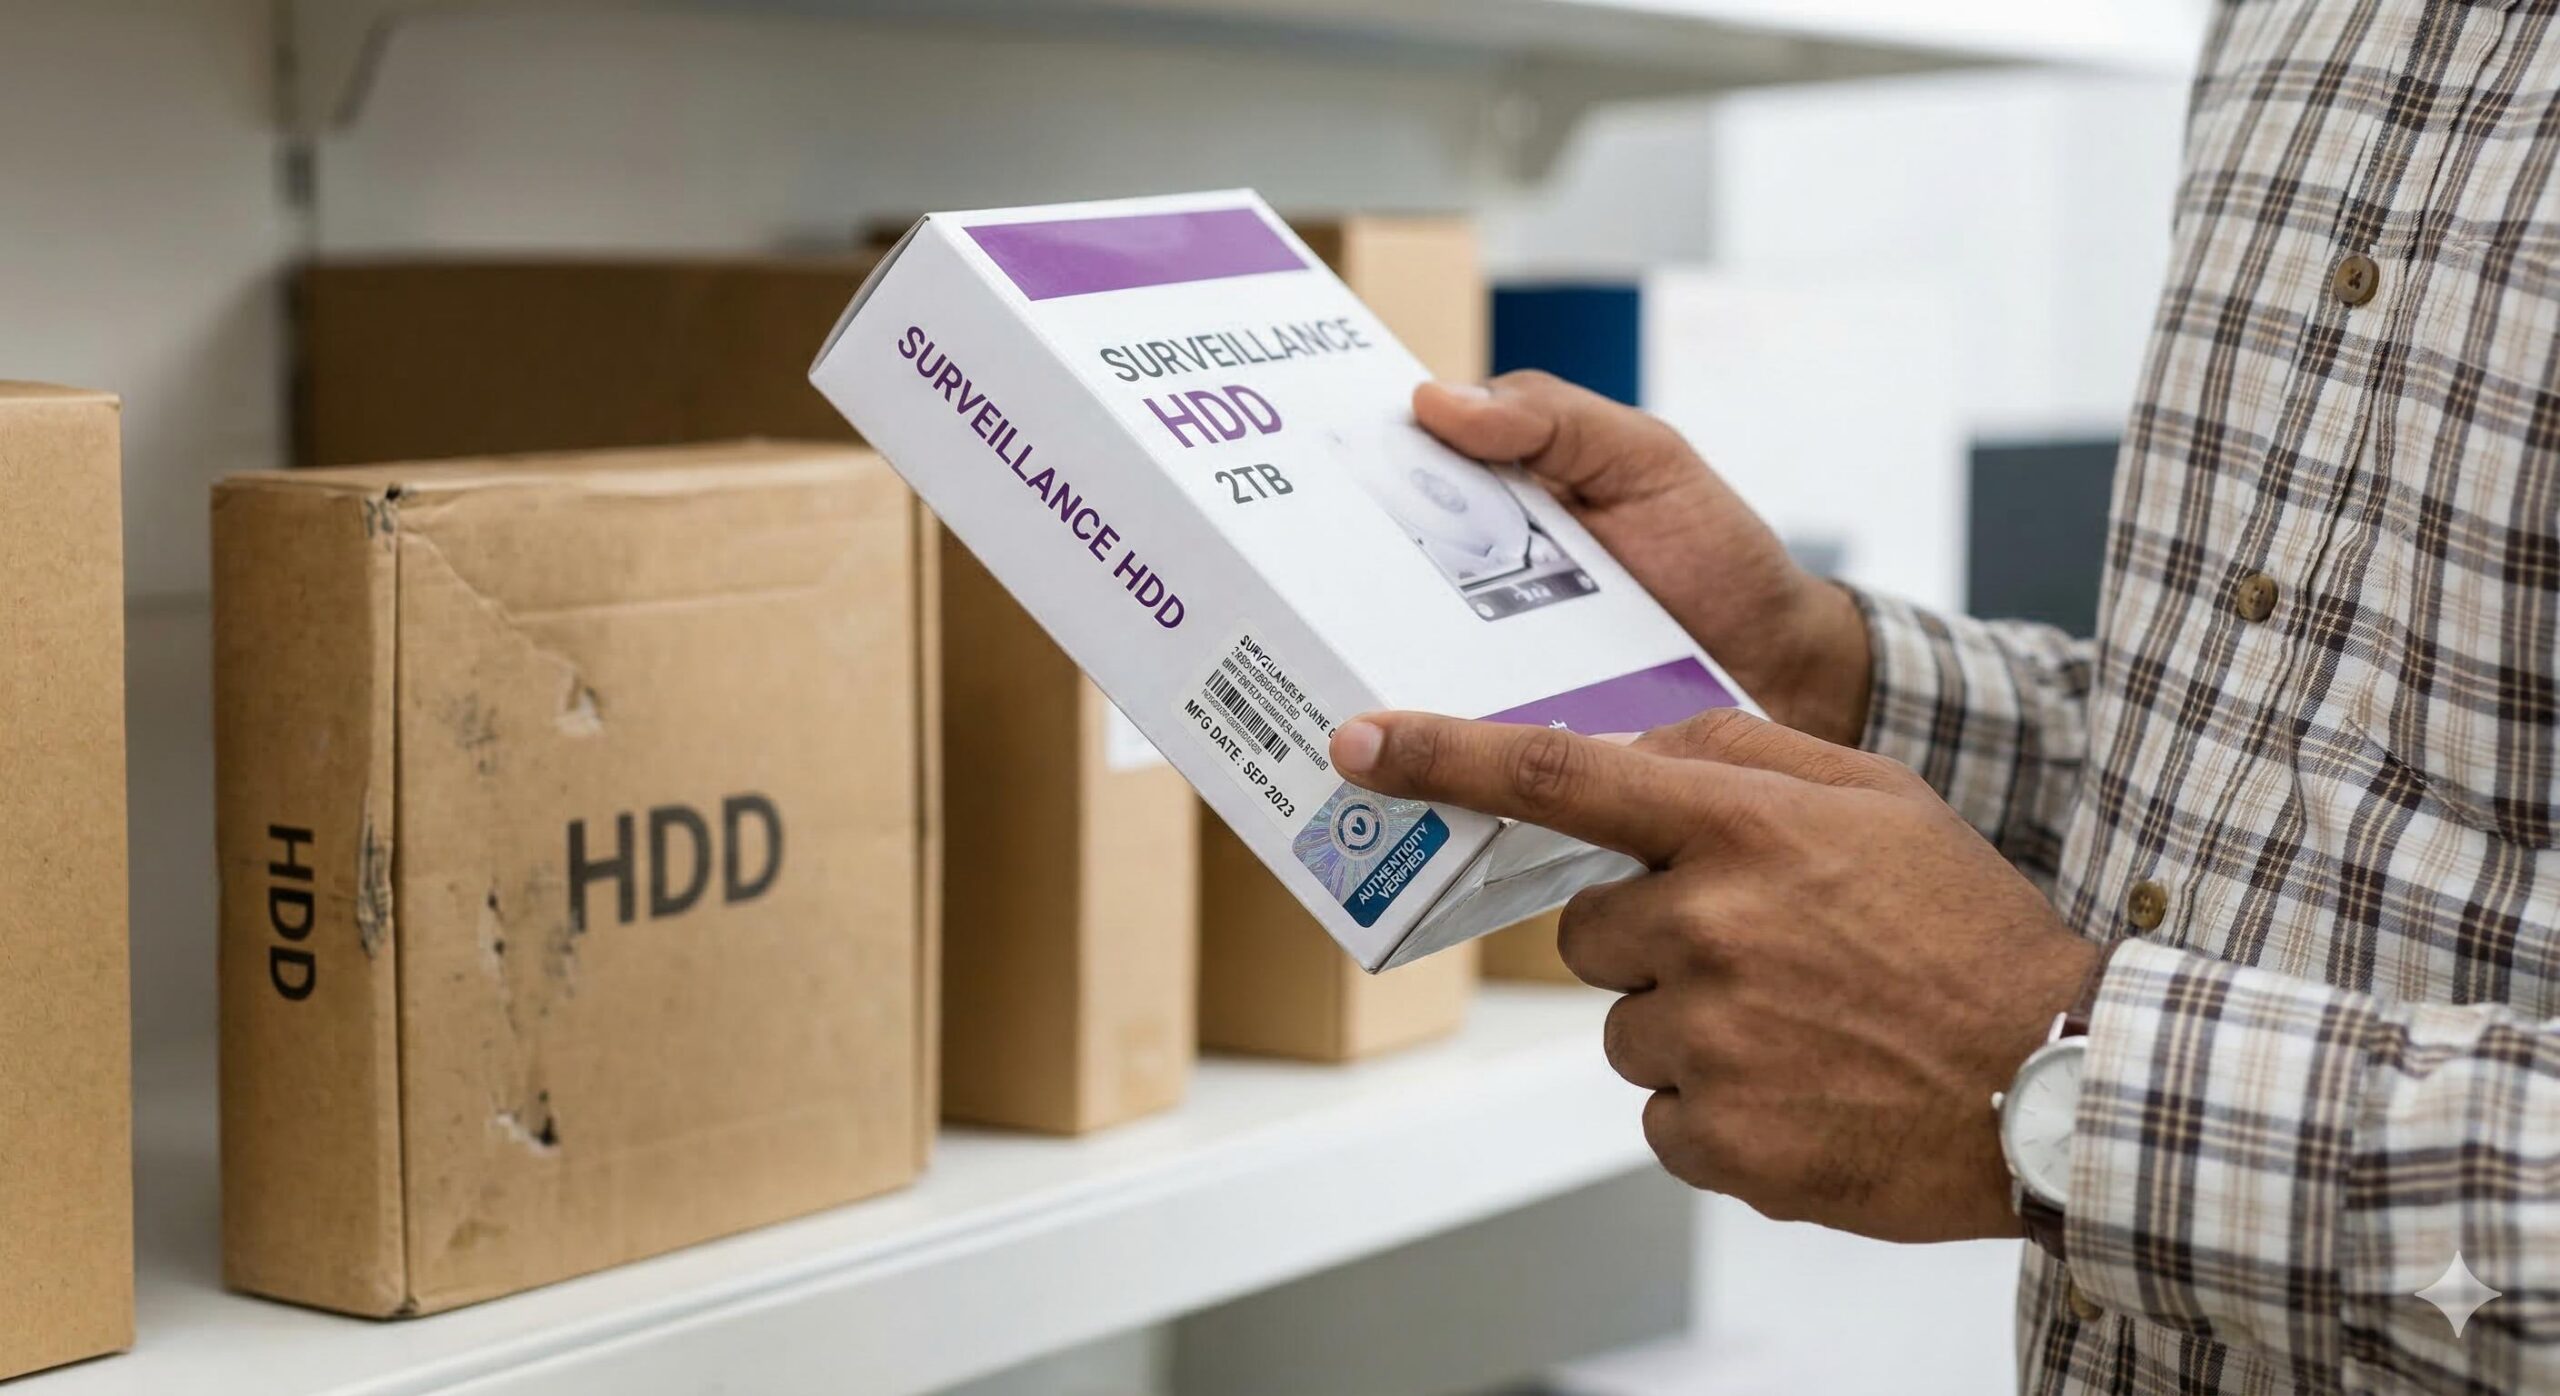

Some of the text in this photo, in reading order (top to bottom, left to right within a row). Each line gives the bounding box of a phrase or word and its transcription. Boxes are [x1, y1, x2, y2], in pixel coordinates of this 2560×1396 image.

[1099, 318, 1371, 383] SURVEILLANCE
[1142, 384, 1283, 449] HDD
[897, 325, 1185, 630] SURVEILLANCE HDD
[1214, 463, 1294, 505] 2TB
[1184, 699, 1212, 729] MFG
[1209, 725, 1245, 766] DATE:
[1243, 761, 1268, 786] SEP
[1264, 785, 1295, 818] 2023
[567, 792, 784, 934] HDD
[1378, 848, 1426, 899] VERIFIED
[267, 823, 317, 1002] HDD
